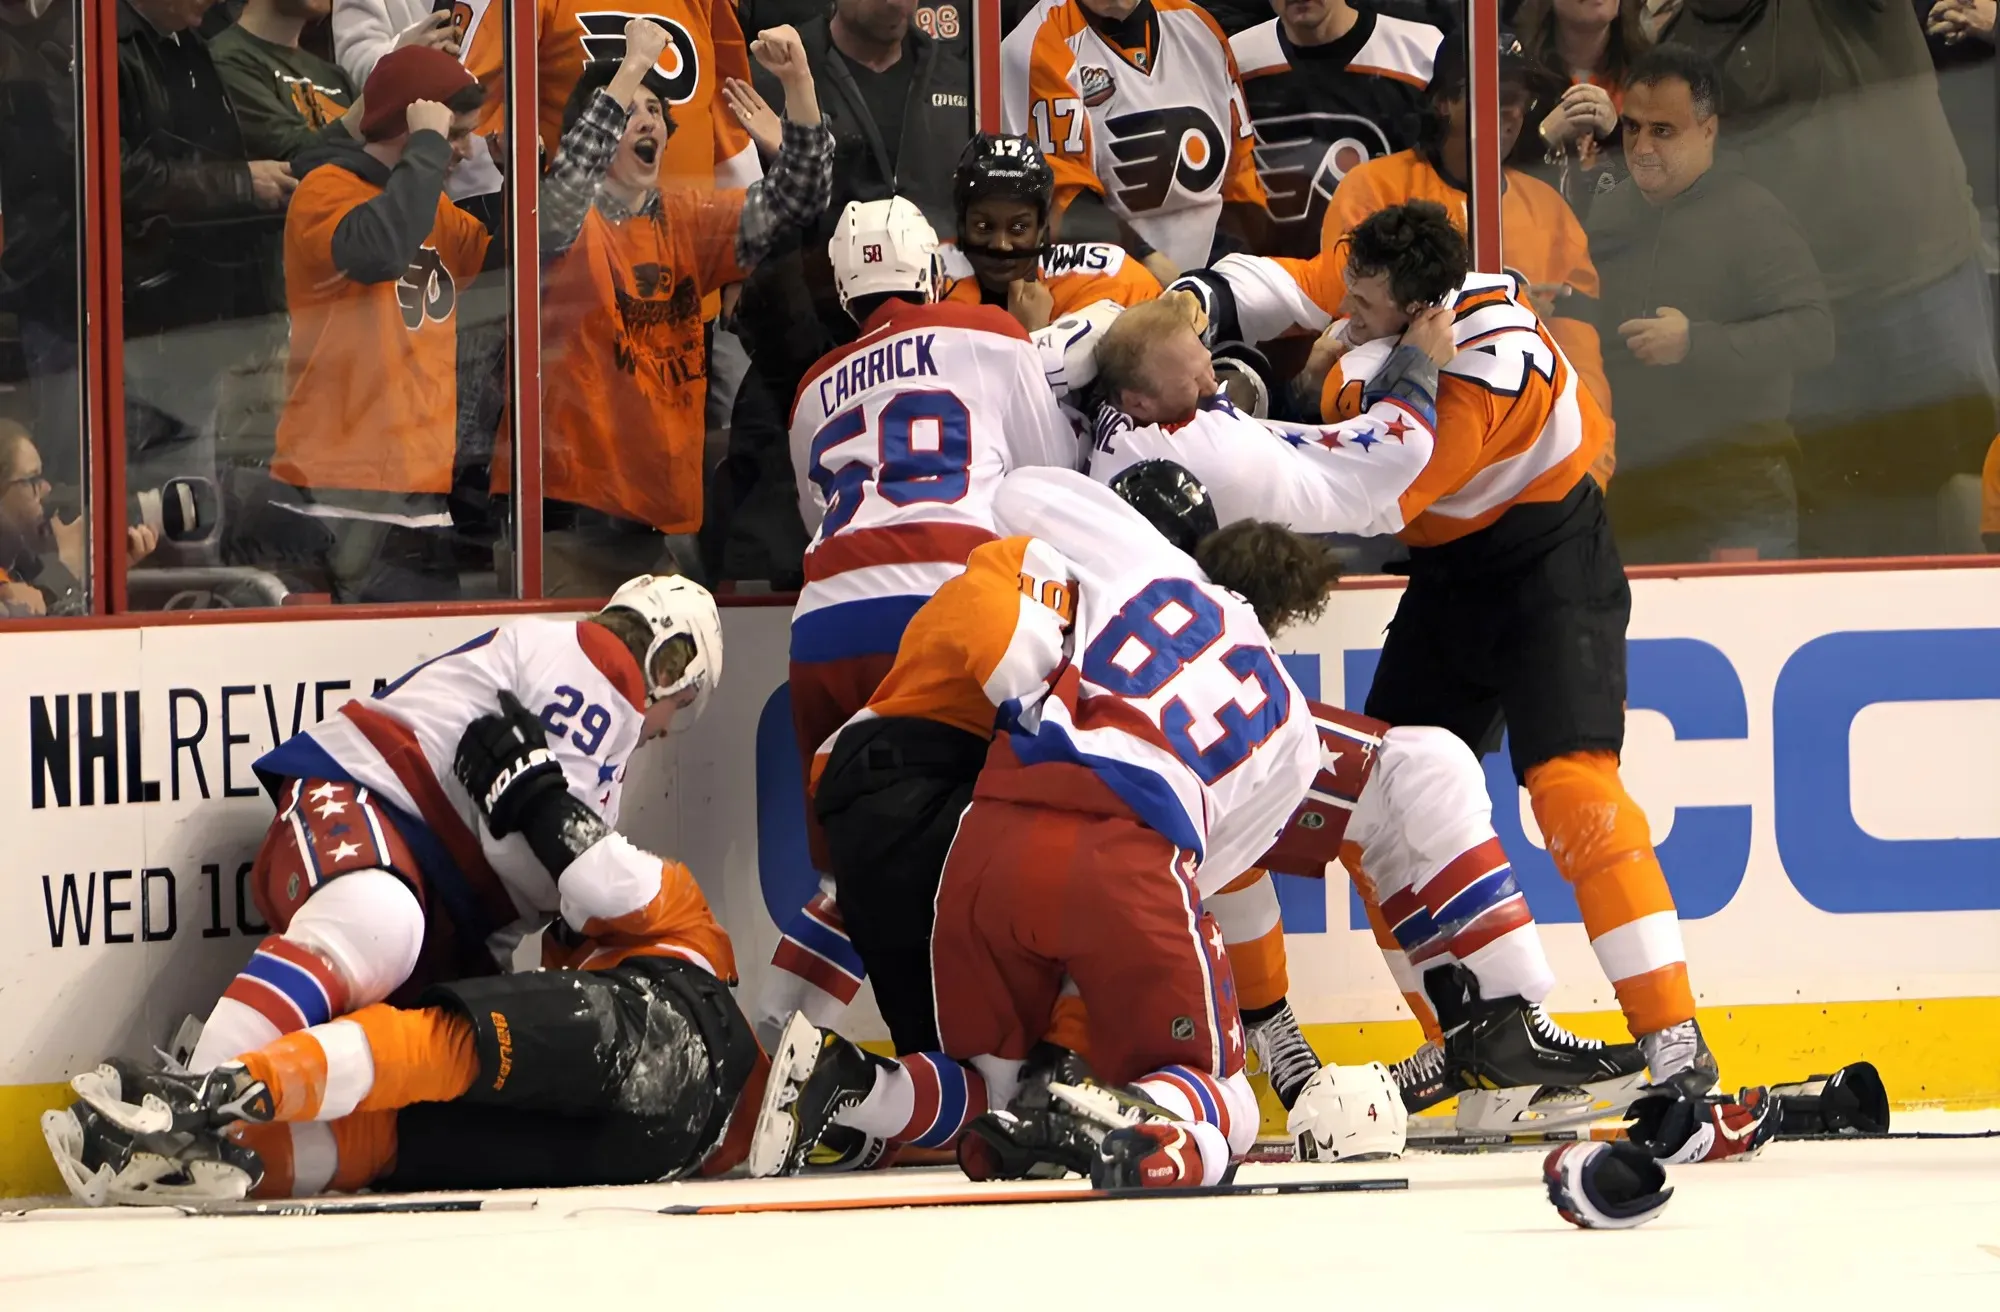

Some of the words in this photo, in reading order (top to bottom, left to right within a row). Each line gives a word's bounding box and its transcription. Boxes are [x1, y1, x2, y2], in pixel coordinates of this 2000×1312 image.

[993, 139, 1022, 157] 17
[1032, 98, 1084, 153] 17
[819, 334, 939, 419] CARRICK
[808, 389, 972, 541] 58
[539, 684, 611, 756] 29
[1080, 577, 1290, 787] 83
[42, 866, 178, 948] WED
[1368, 1102, 1378, 1122] 4
